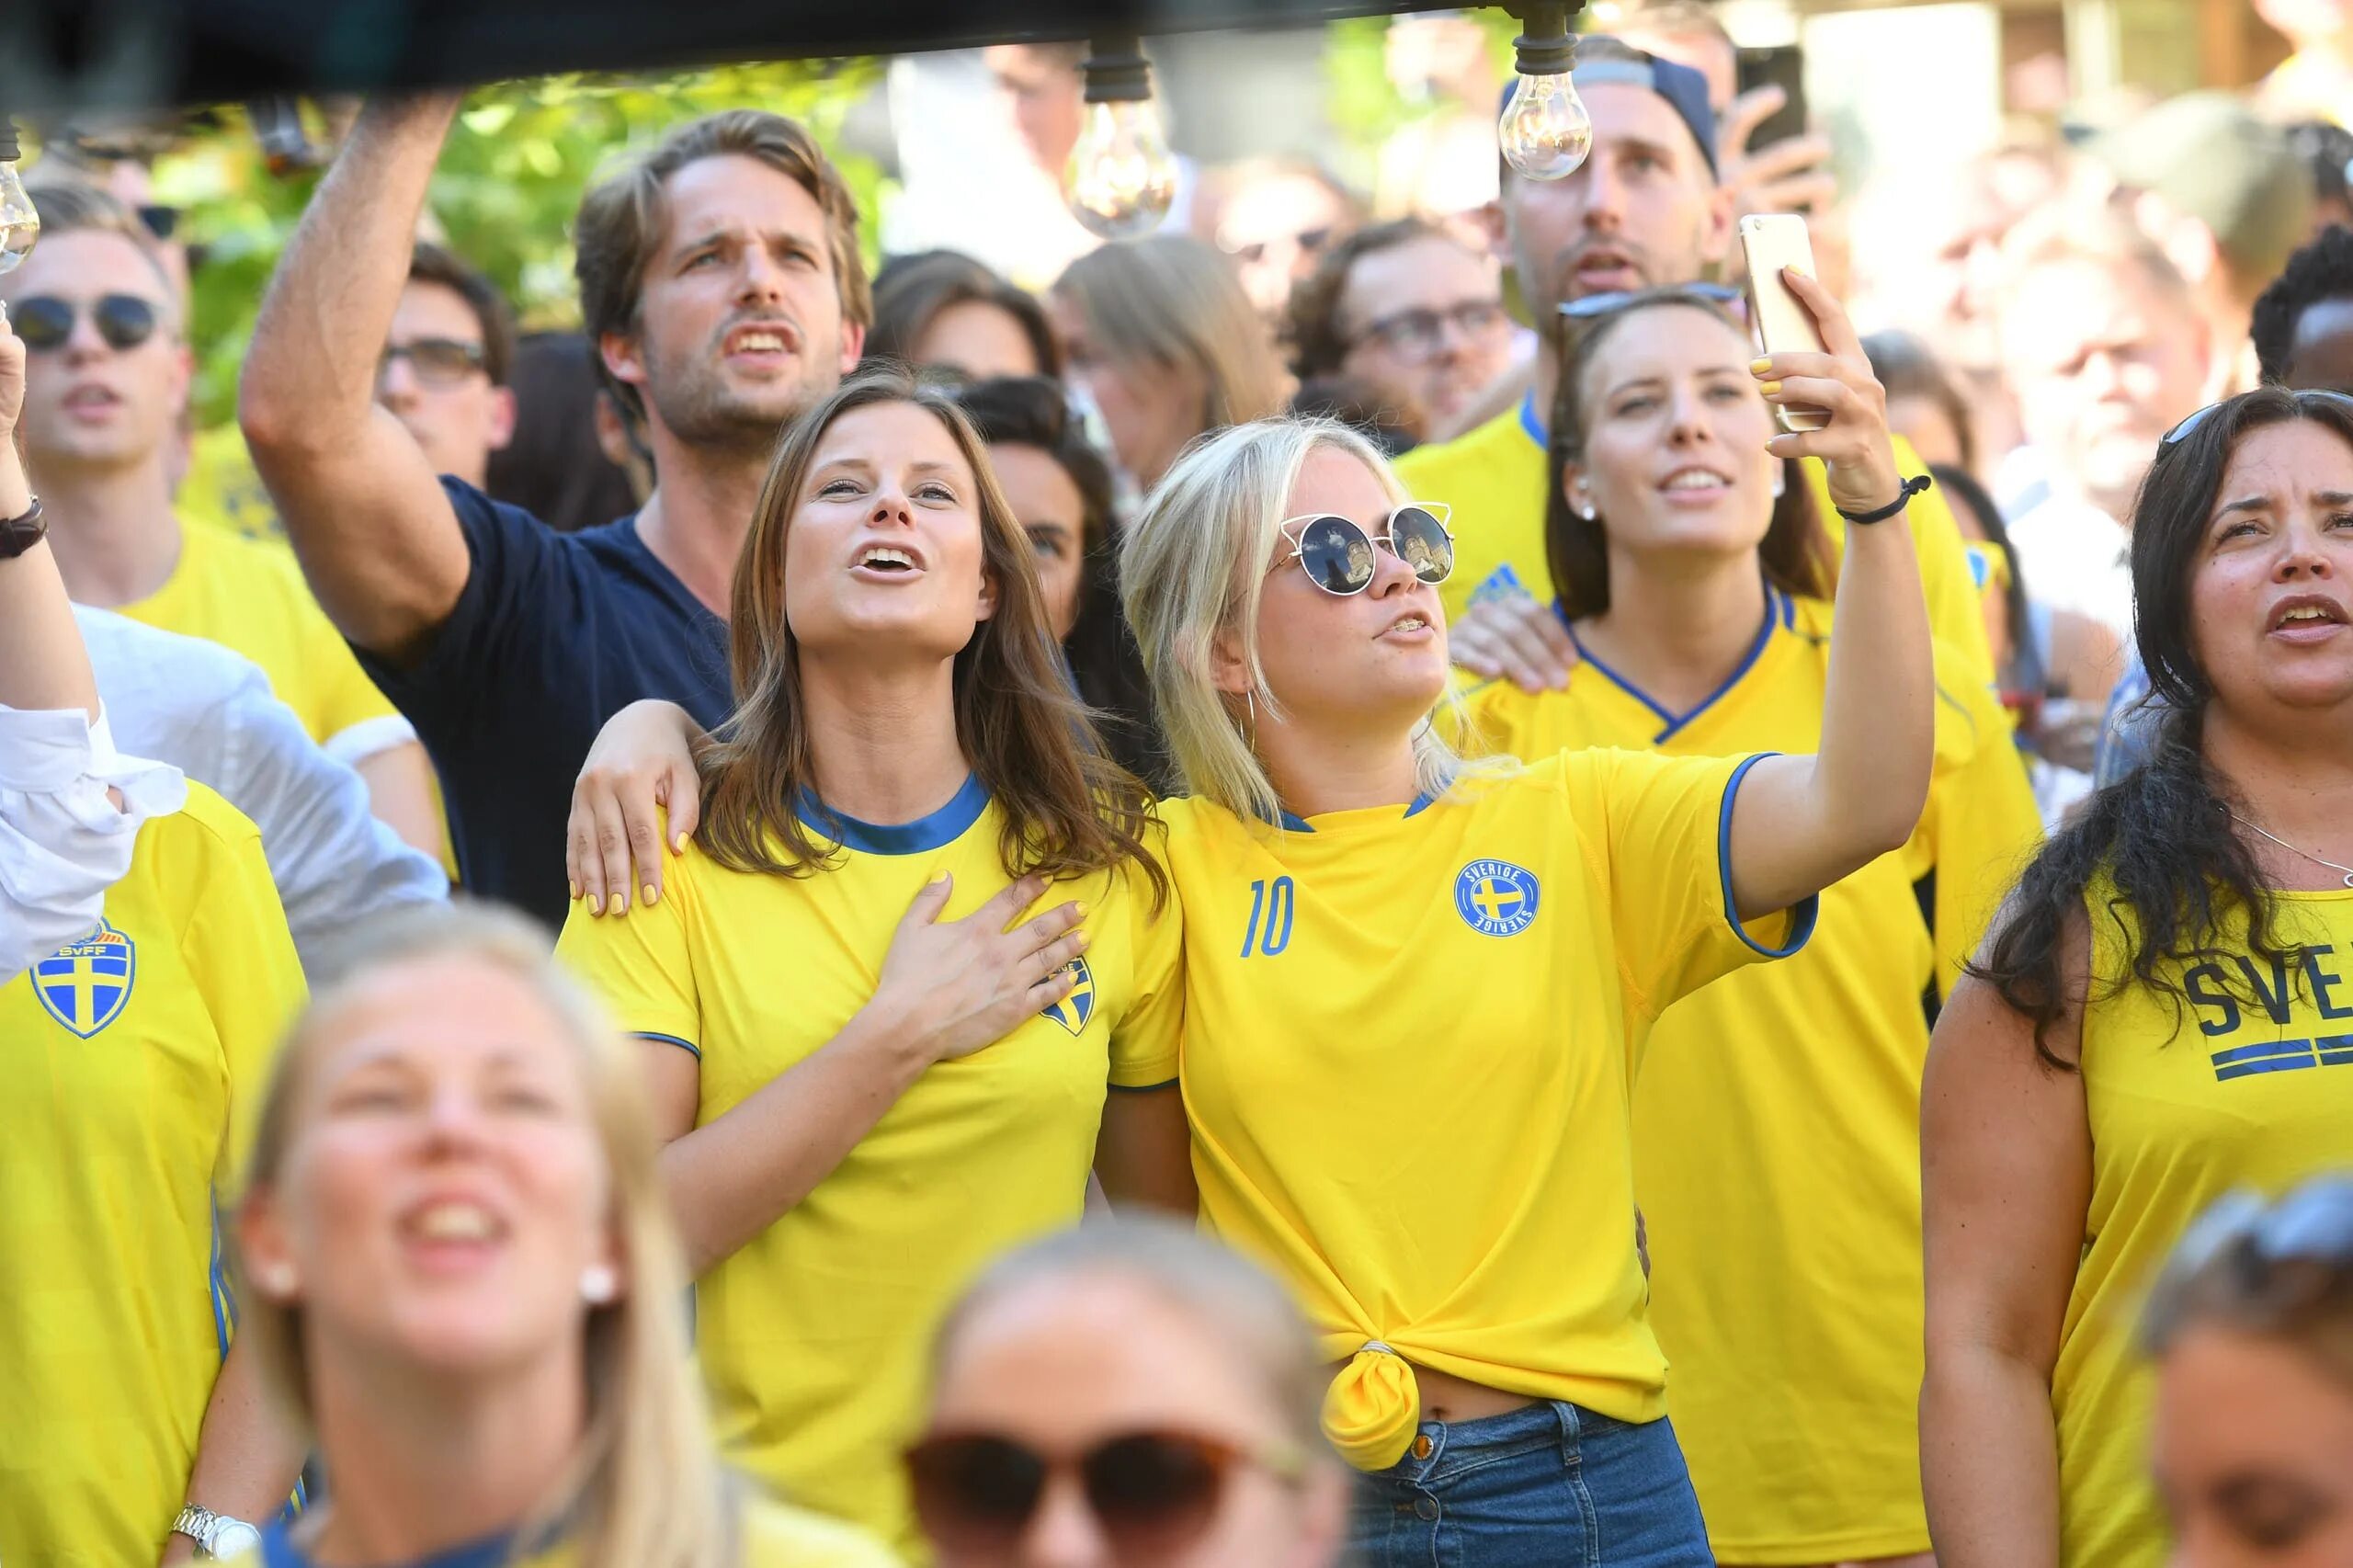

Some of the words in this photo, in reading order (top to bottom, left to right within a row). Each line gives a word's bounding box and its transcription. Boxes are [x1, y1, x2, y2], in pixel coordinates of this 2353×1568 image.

[1465, 863, 1521, 882] SVERIGE
[1240, 875, 1294, 958] 10
[1474, 910, 1533, 933] SVERIGE
[2184, 941, 2353, 1036] SVE
